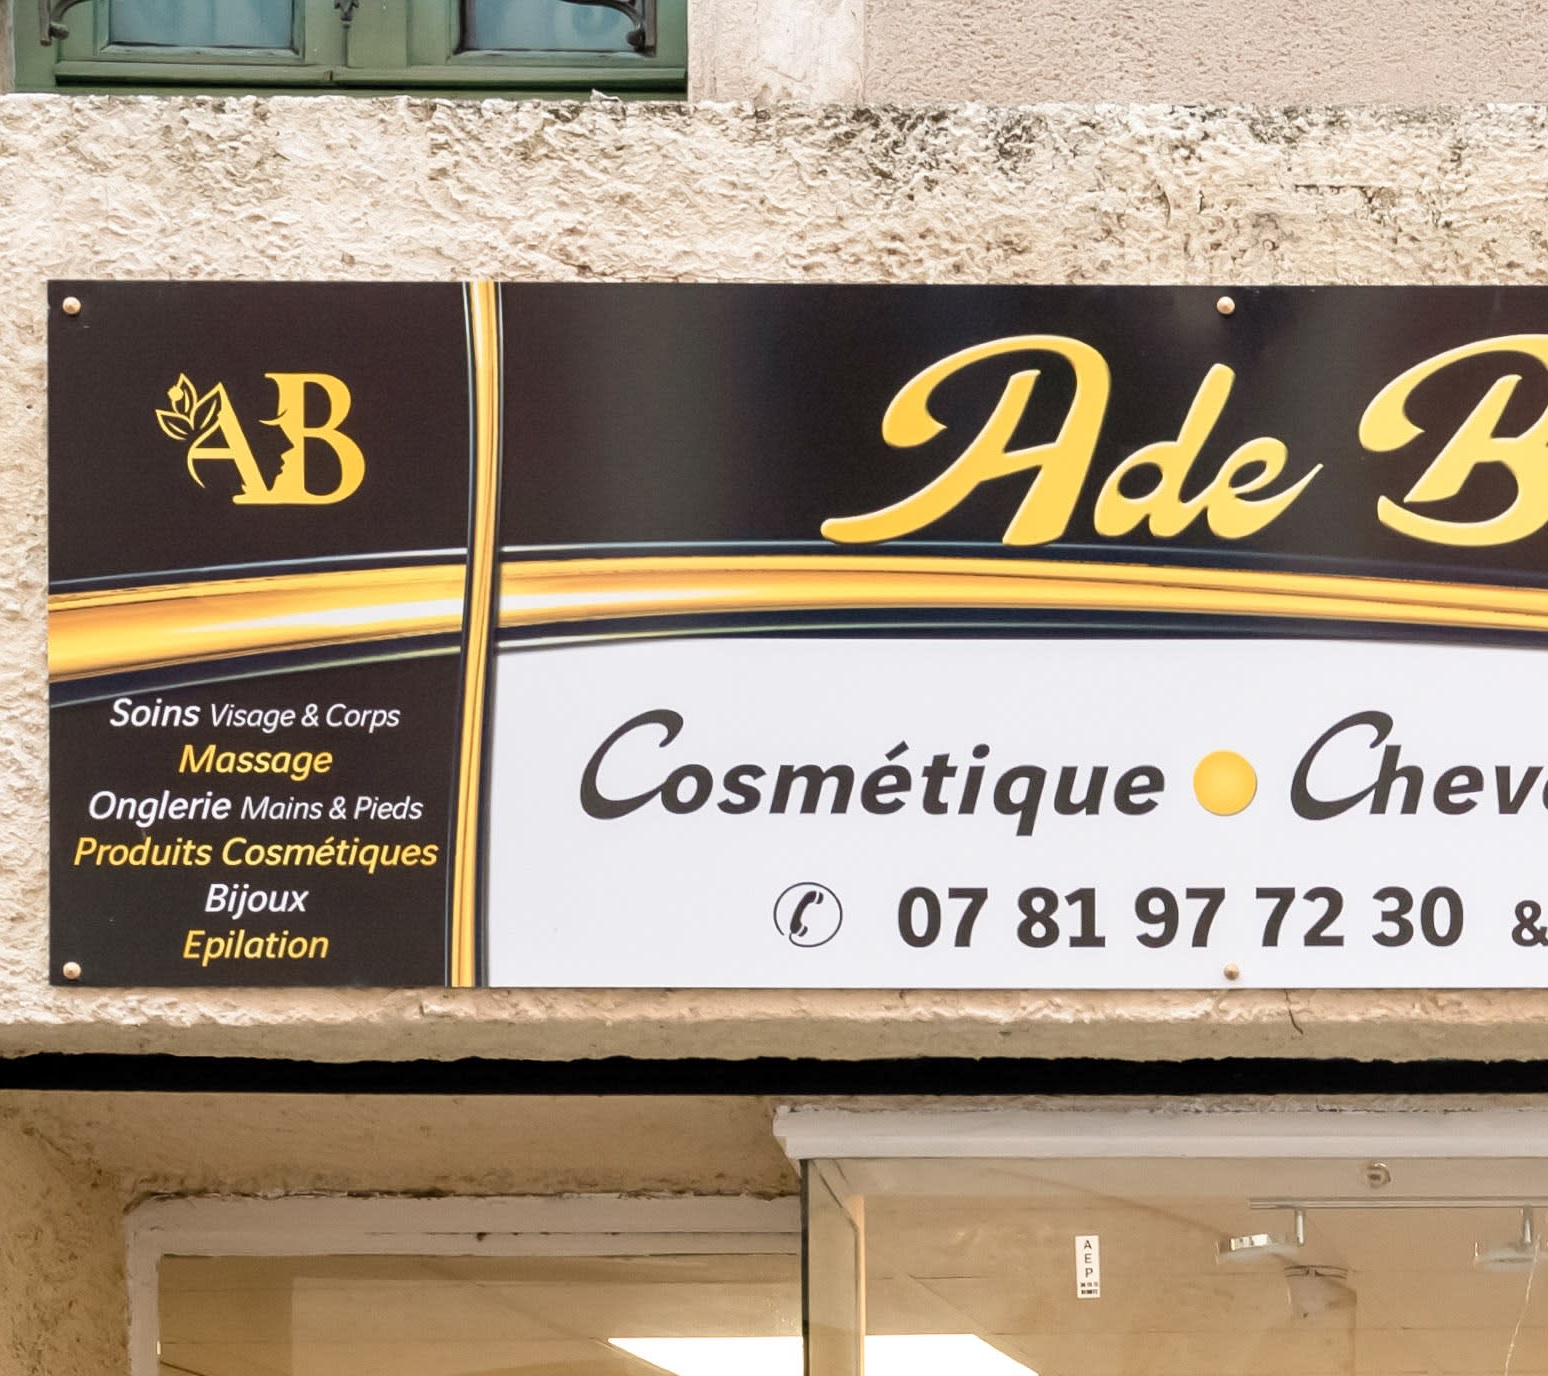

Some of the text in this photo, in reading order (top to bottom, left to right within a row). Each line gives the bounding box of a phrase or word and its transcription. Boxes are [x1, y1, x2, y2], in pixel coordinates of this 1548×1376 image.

[819, 332, 1324, 548] Ade
[109, 697, 401, 734] Soins Visage & Corps
[178, 744, 333, 782] Massage
[579, 708, 1165, 837] Cosmétique
[88, 789, 424, 828] Onglerie Mains & Pieds
[73, 836, 440, 875] Produits Cosmétiques
[204, 883, 309, 920] Bijoux
[897, 886, 989, 948] 07
[1017, 886, 1106, 949] 81
[1134, 886, 1226, 949] 97
[1255, 886, 1345, 948] 72
[1371, 886, 1464, 948] 30
[183, 928, 329, 967] Epilation
